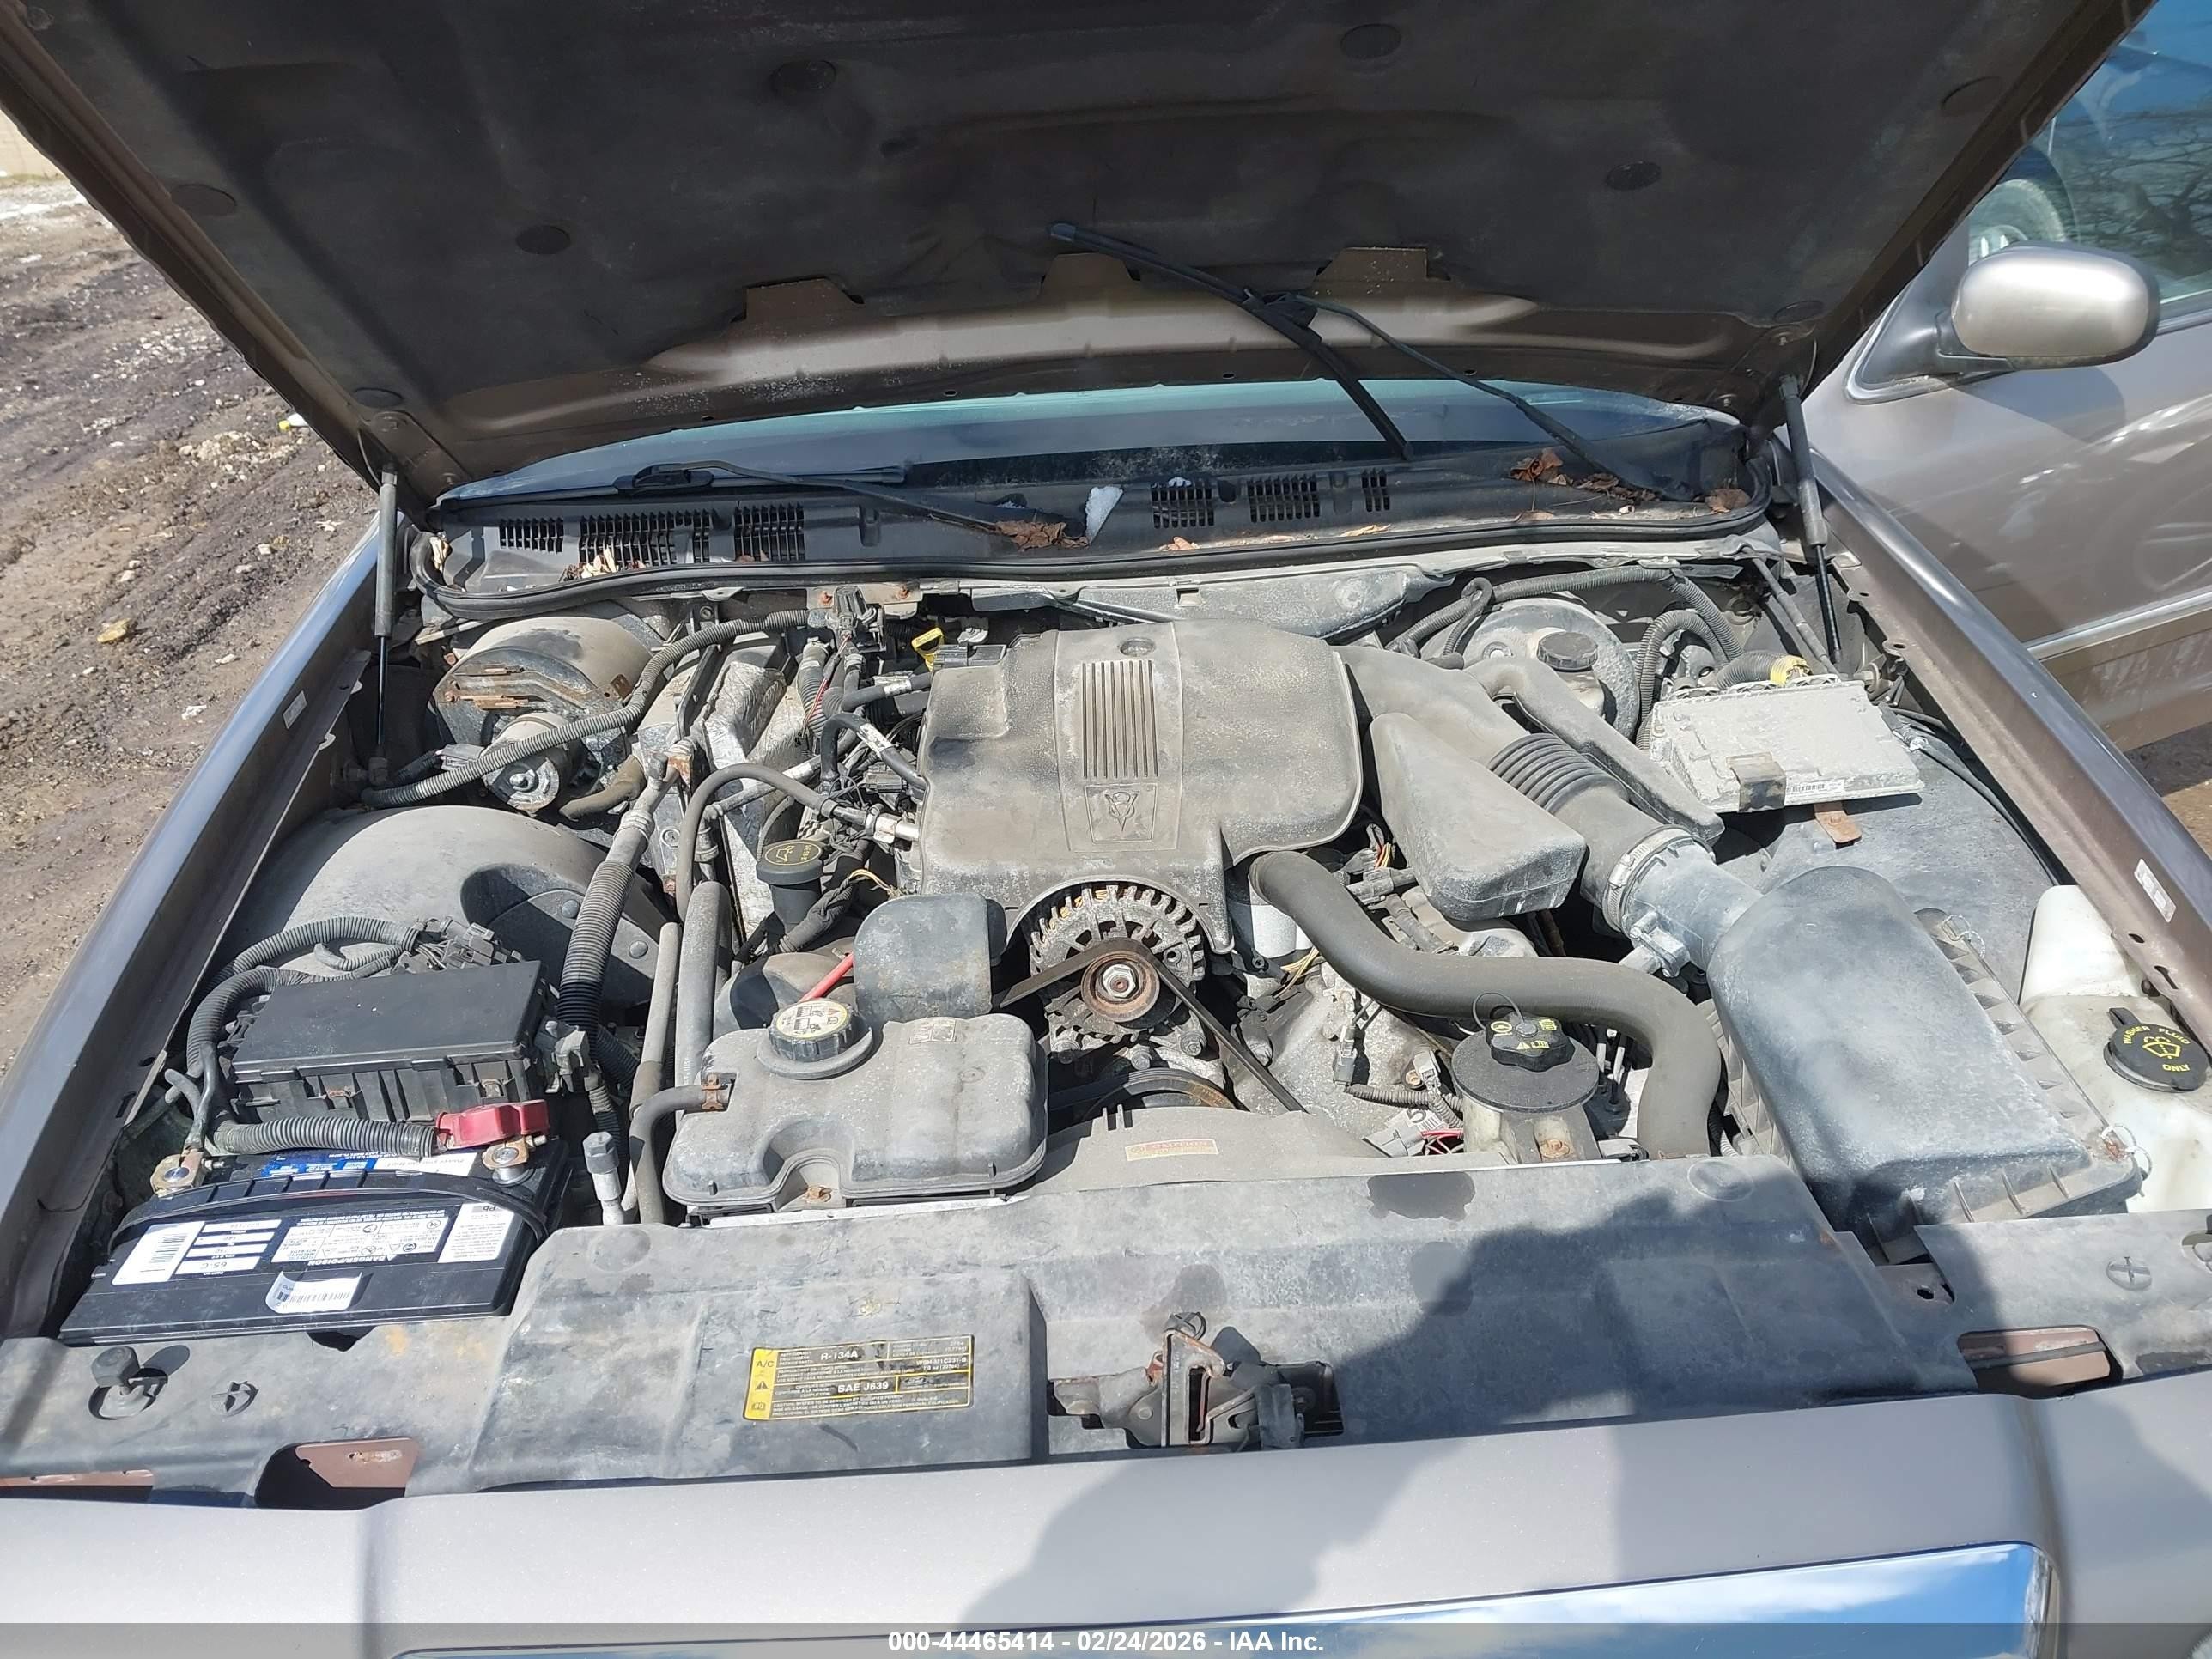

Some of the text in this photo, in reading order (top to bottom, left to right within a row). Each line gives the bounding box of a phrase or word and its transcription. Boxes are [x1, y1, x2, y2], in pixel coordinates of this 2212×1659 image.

[2123, 1025, 2191, 1044] WASHER FLUID
[820, 1349, 859, 1360] R-134A
[837, 1382, 860, 1393] SAE
[863, 1381, 889, 1391] J639
